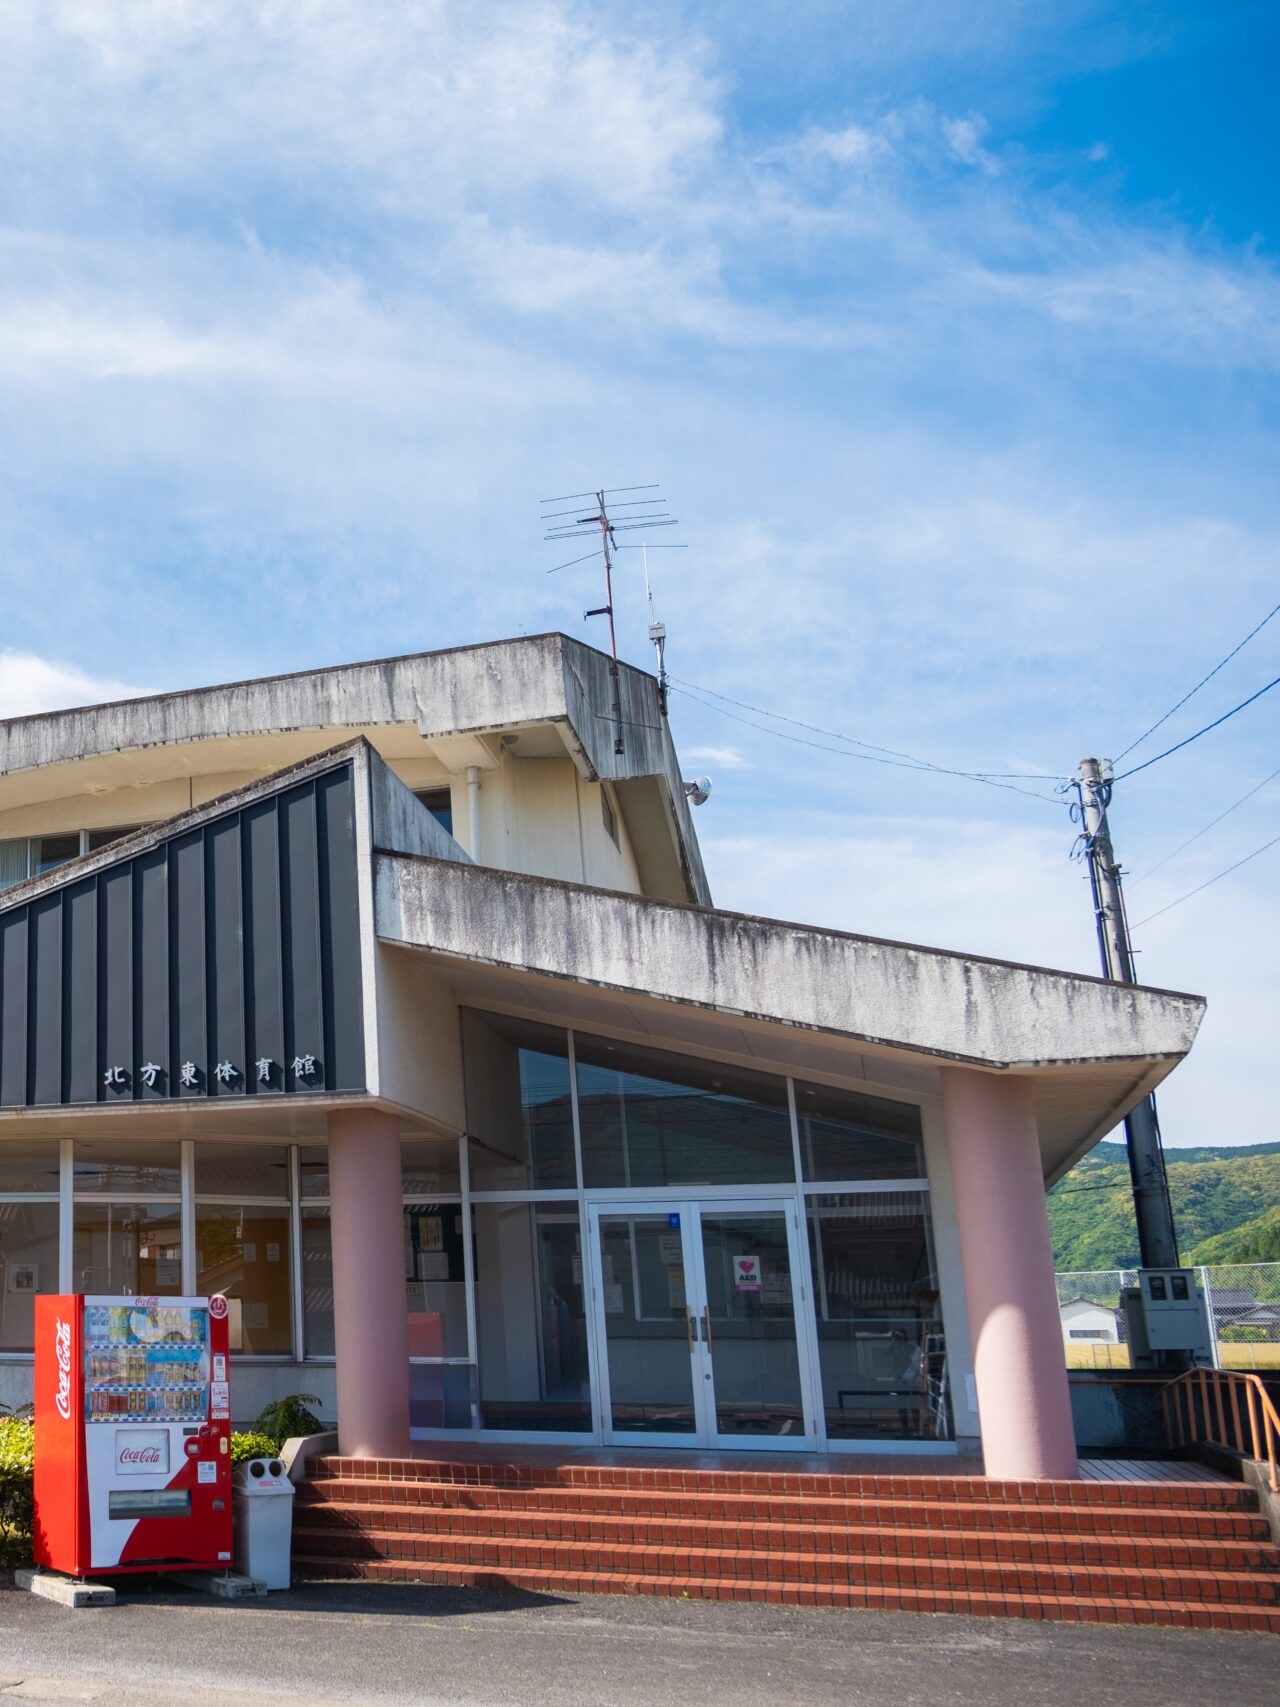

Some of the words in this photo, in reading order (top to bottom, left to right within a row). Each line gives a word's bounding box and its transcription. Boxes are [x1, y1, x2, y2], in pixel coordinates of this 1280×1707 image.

[104, 1054, 316, 1087] 北方東体育館
